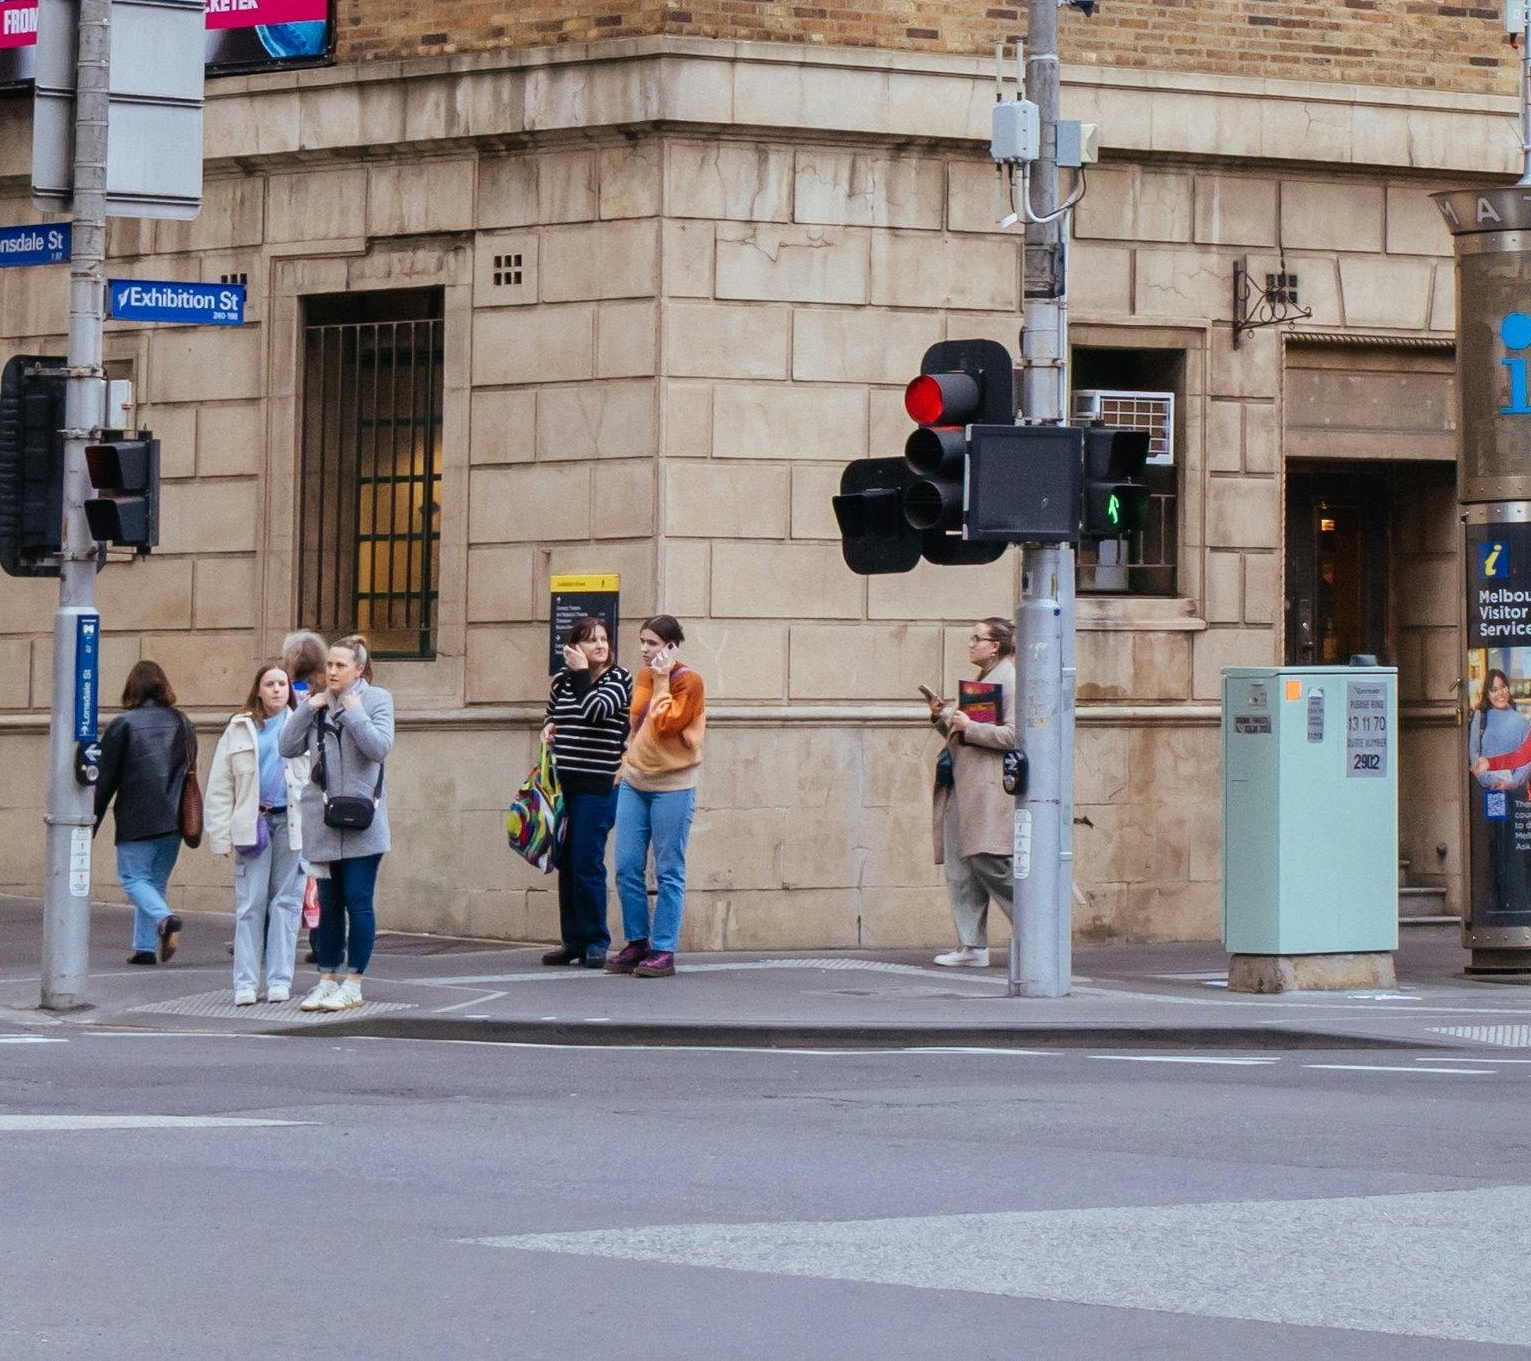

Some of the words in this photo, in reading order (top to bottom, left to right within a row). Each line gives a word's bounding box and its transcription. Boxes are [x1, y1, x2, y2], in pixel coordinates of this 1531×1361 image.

[48, 230, 64, 250] St
[130, 286, 215, 309] Exhibition
[219, 290, 239, 311] St
[1479, 605, 1529, 620] Visitor
[1348, 717, 1359, 731] 13
[1361, 716, 1370, 731] 11
[1373, 716, 1386, 731] 70
[1353, 753, 1380, 770] 2902
[1515, 821, 1524, 829] to
[1515, 842, 1531, 850] Ask
